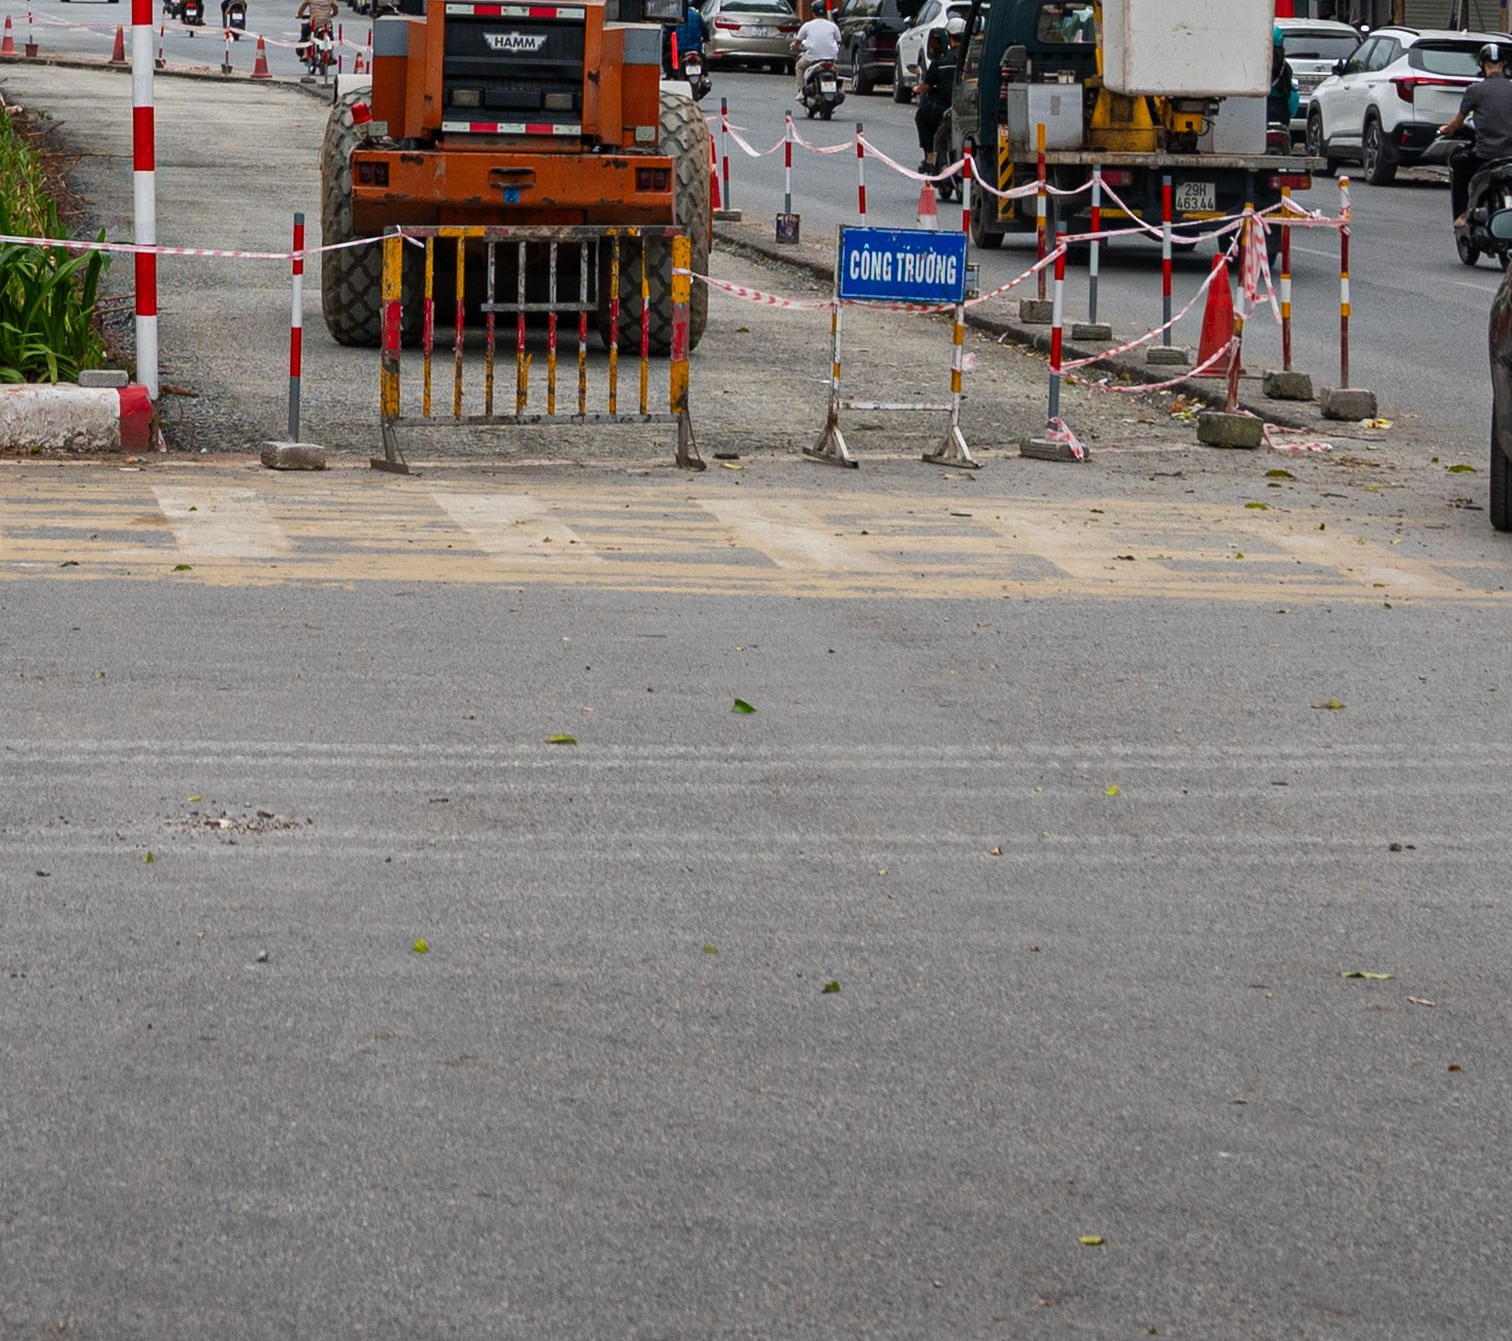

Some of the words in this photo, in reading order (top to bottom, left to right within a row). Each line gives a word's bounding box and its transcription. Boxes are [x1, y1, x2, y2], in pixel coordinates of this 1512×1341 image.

[494, 36, 536, 49] HAMM
[1185, 183, 1207, 196] 29H
[1177, 198, 1214, 210] 463.44
[849, 243, 893, 282] CÔNG
[896, 245, 957, 285] TRƯỜNG
